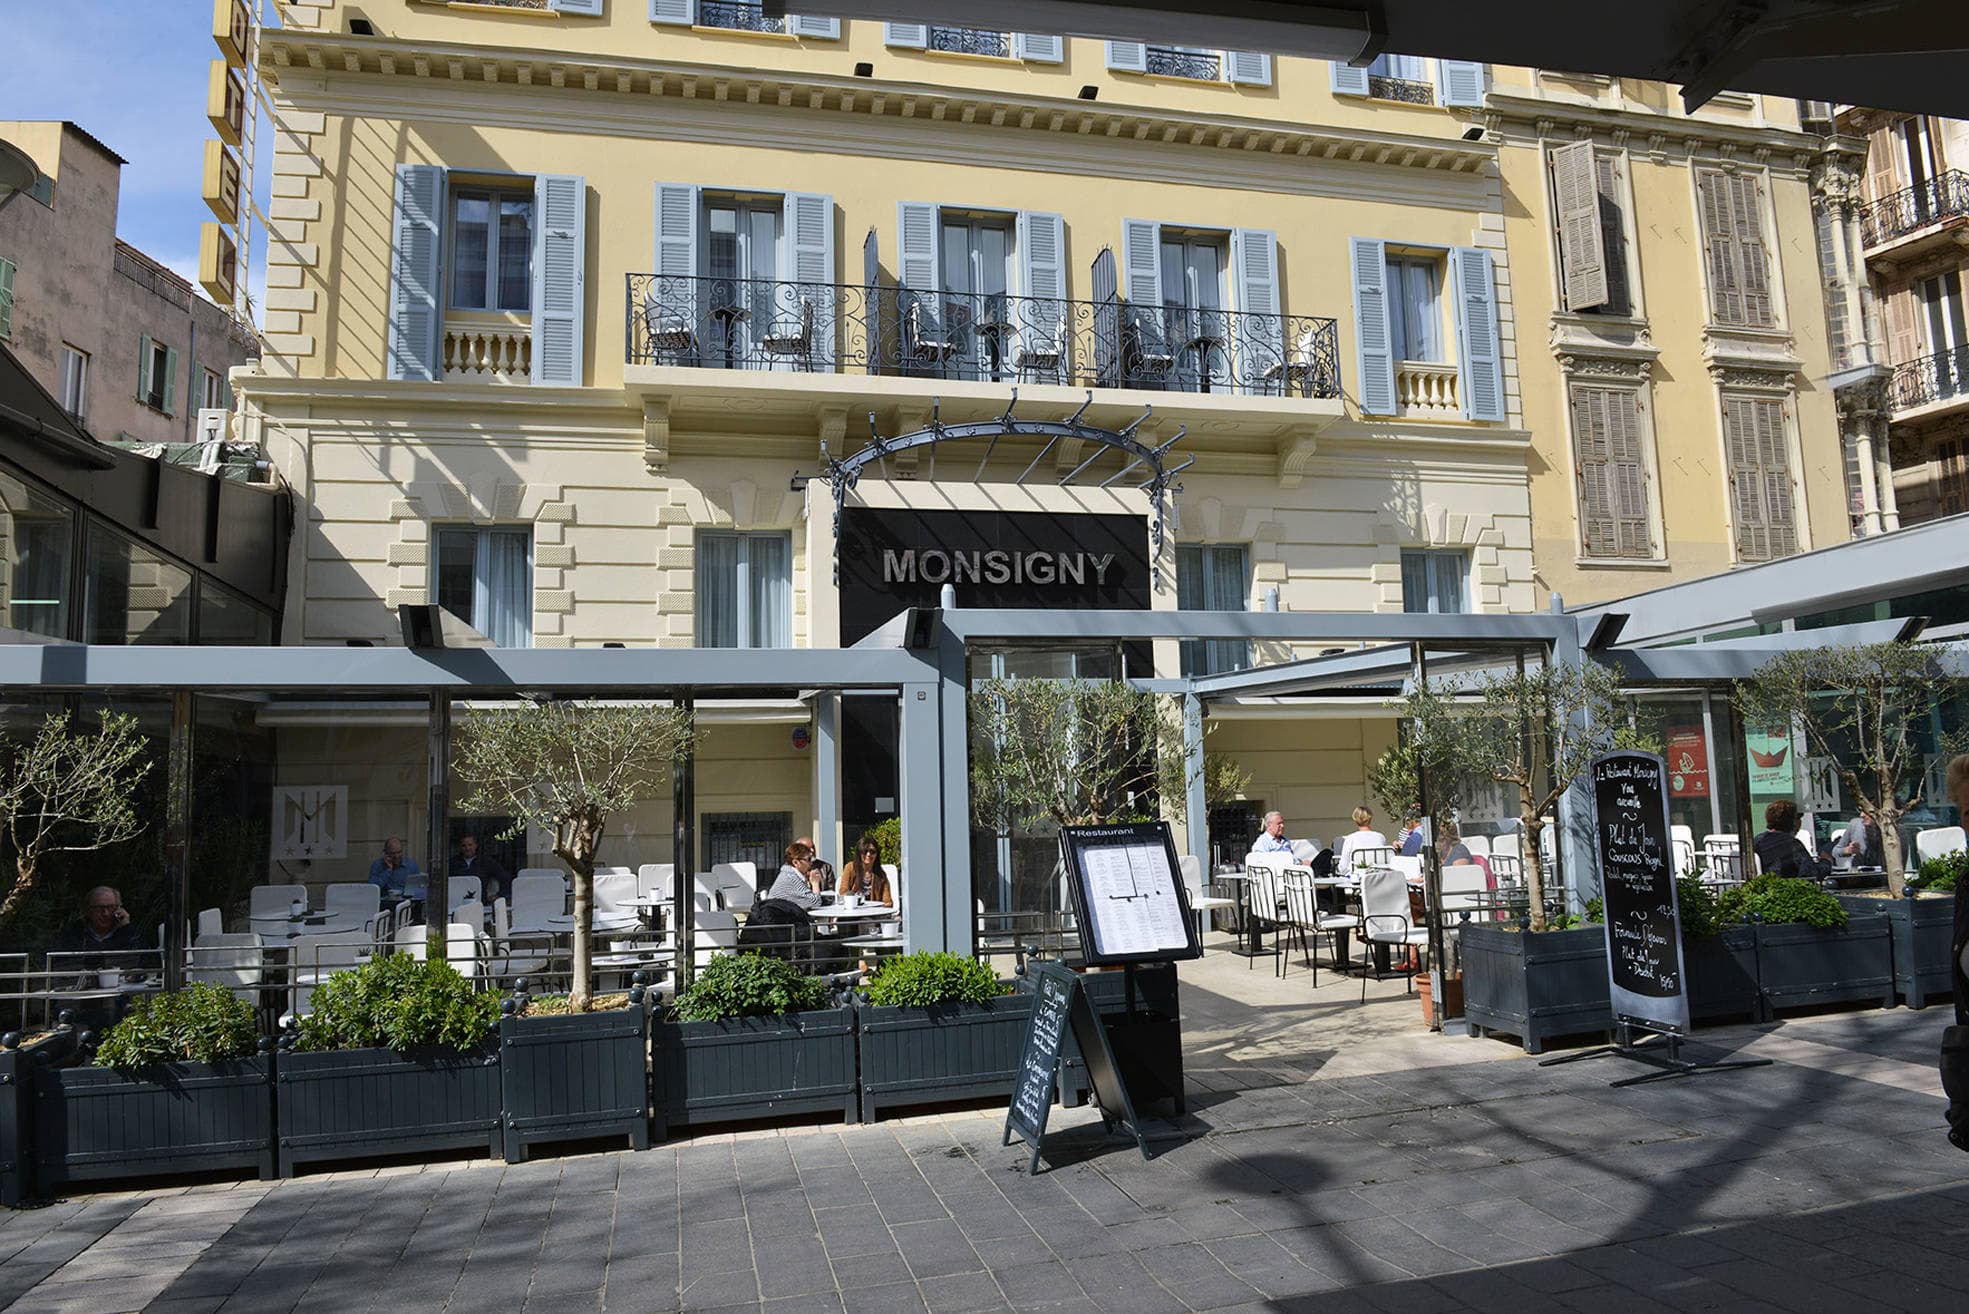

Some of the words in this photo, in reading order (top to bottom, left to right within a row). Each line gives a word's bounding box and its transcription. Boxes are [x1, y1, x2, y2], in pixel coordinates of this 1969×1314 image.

[883, 549, 1115, 585] MONSIGNY
[1077, 828, 1134, 838] Restaurant
[1608, 847, 1642, 865] Couscous
